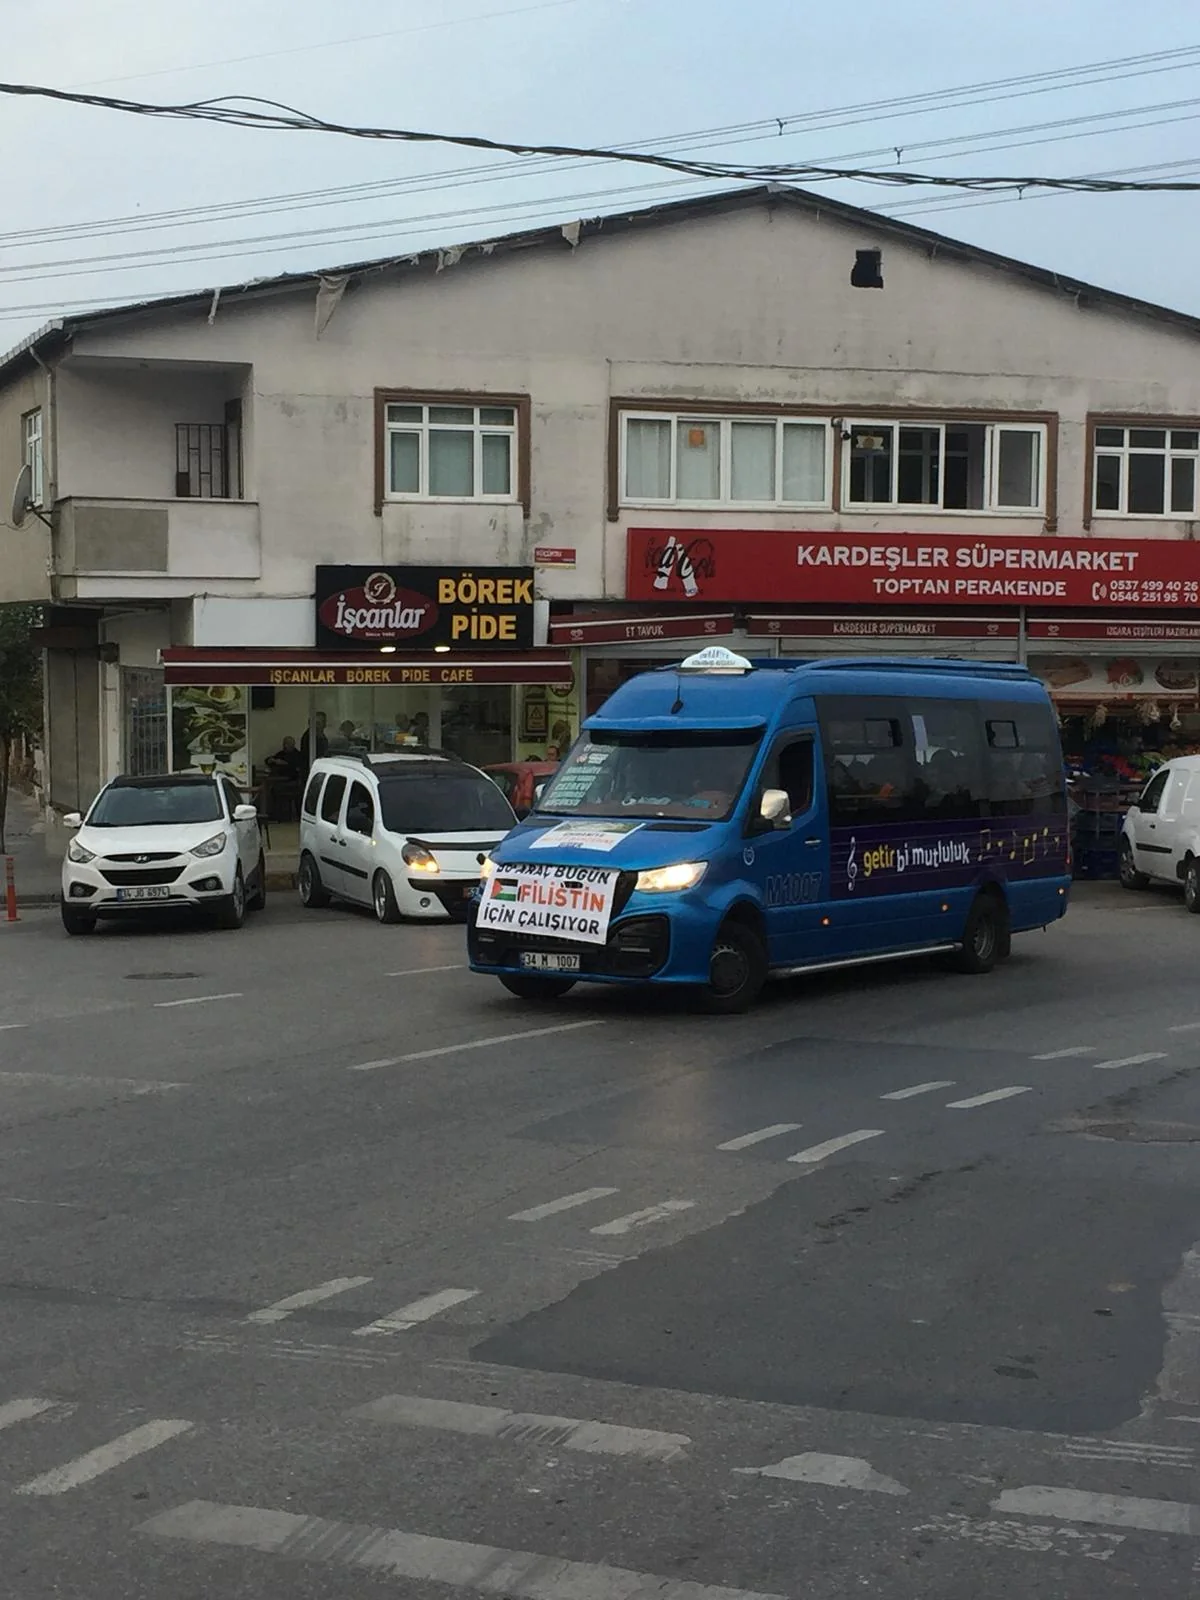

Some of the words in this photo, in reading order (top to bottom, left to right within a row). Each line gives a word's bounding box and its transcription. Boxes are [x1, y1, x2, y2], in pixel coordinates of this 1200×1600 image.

[797, 545, 949, 572] KARDEŞLER
[955, 543, 1139, 571] SÜPERMARKET
[438, 573, 533, 604] BÖREK
[872, 578, 950, 595] TOPTAN
[954, 579, 1067, 596] PERAKENDE
[1110, 580, 1139, 590] 0537
[1141, 581, 1164, 591] 499
[1166, 581, 1182, 591] 40
[1183, 582, 1199, 592] 26
[1110, 591, 1140, 602] 0546
[1142, 591, 1161, 602] 251
[1163, 592, 1179, 603] 95
[1183, 592, 1199, 603] 70
[334, 594, 426, 634] İşcanlar
[451, 607, 517, 640] PİDE
[625, 626, 635, 637] ET
[637, 624, 664, 637] TAVUK
[346, 668, 391, 683] BÖREK
[401, 669, 431, 682] PİDE
[440, 669, 474, 682] CAFE
[863, 843, 896, 877] getir
[896, 840, 909, 872] bi
[912, 840, 970, 868] mutluluk
[519, 878, 606, 913] FİLİSTİN
[763, 871, 824, 906] M1007
[483, 902, 515, 923] İÇİN
[518, 910, 600, 935] ÇALIŞIYOR
[525, 953, 537, 965] 34
[556, 956, 579, 968] 1007
